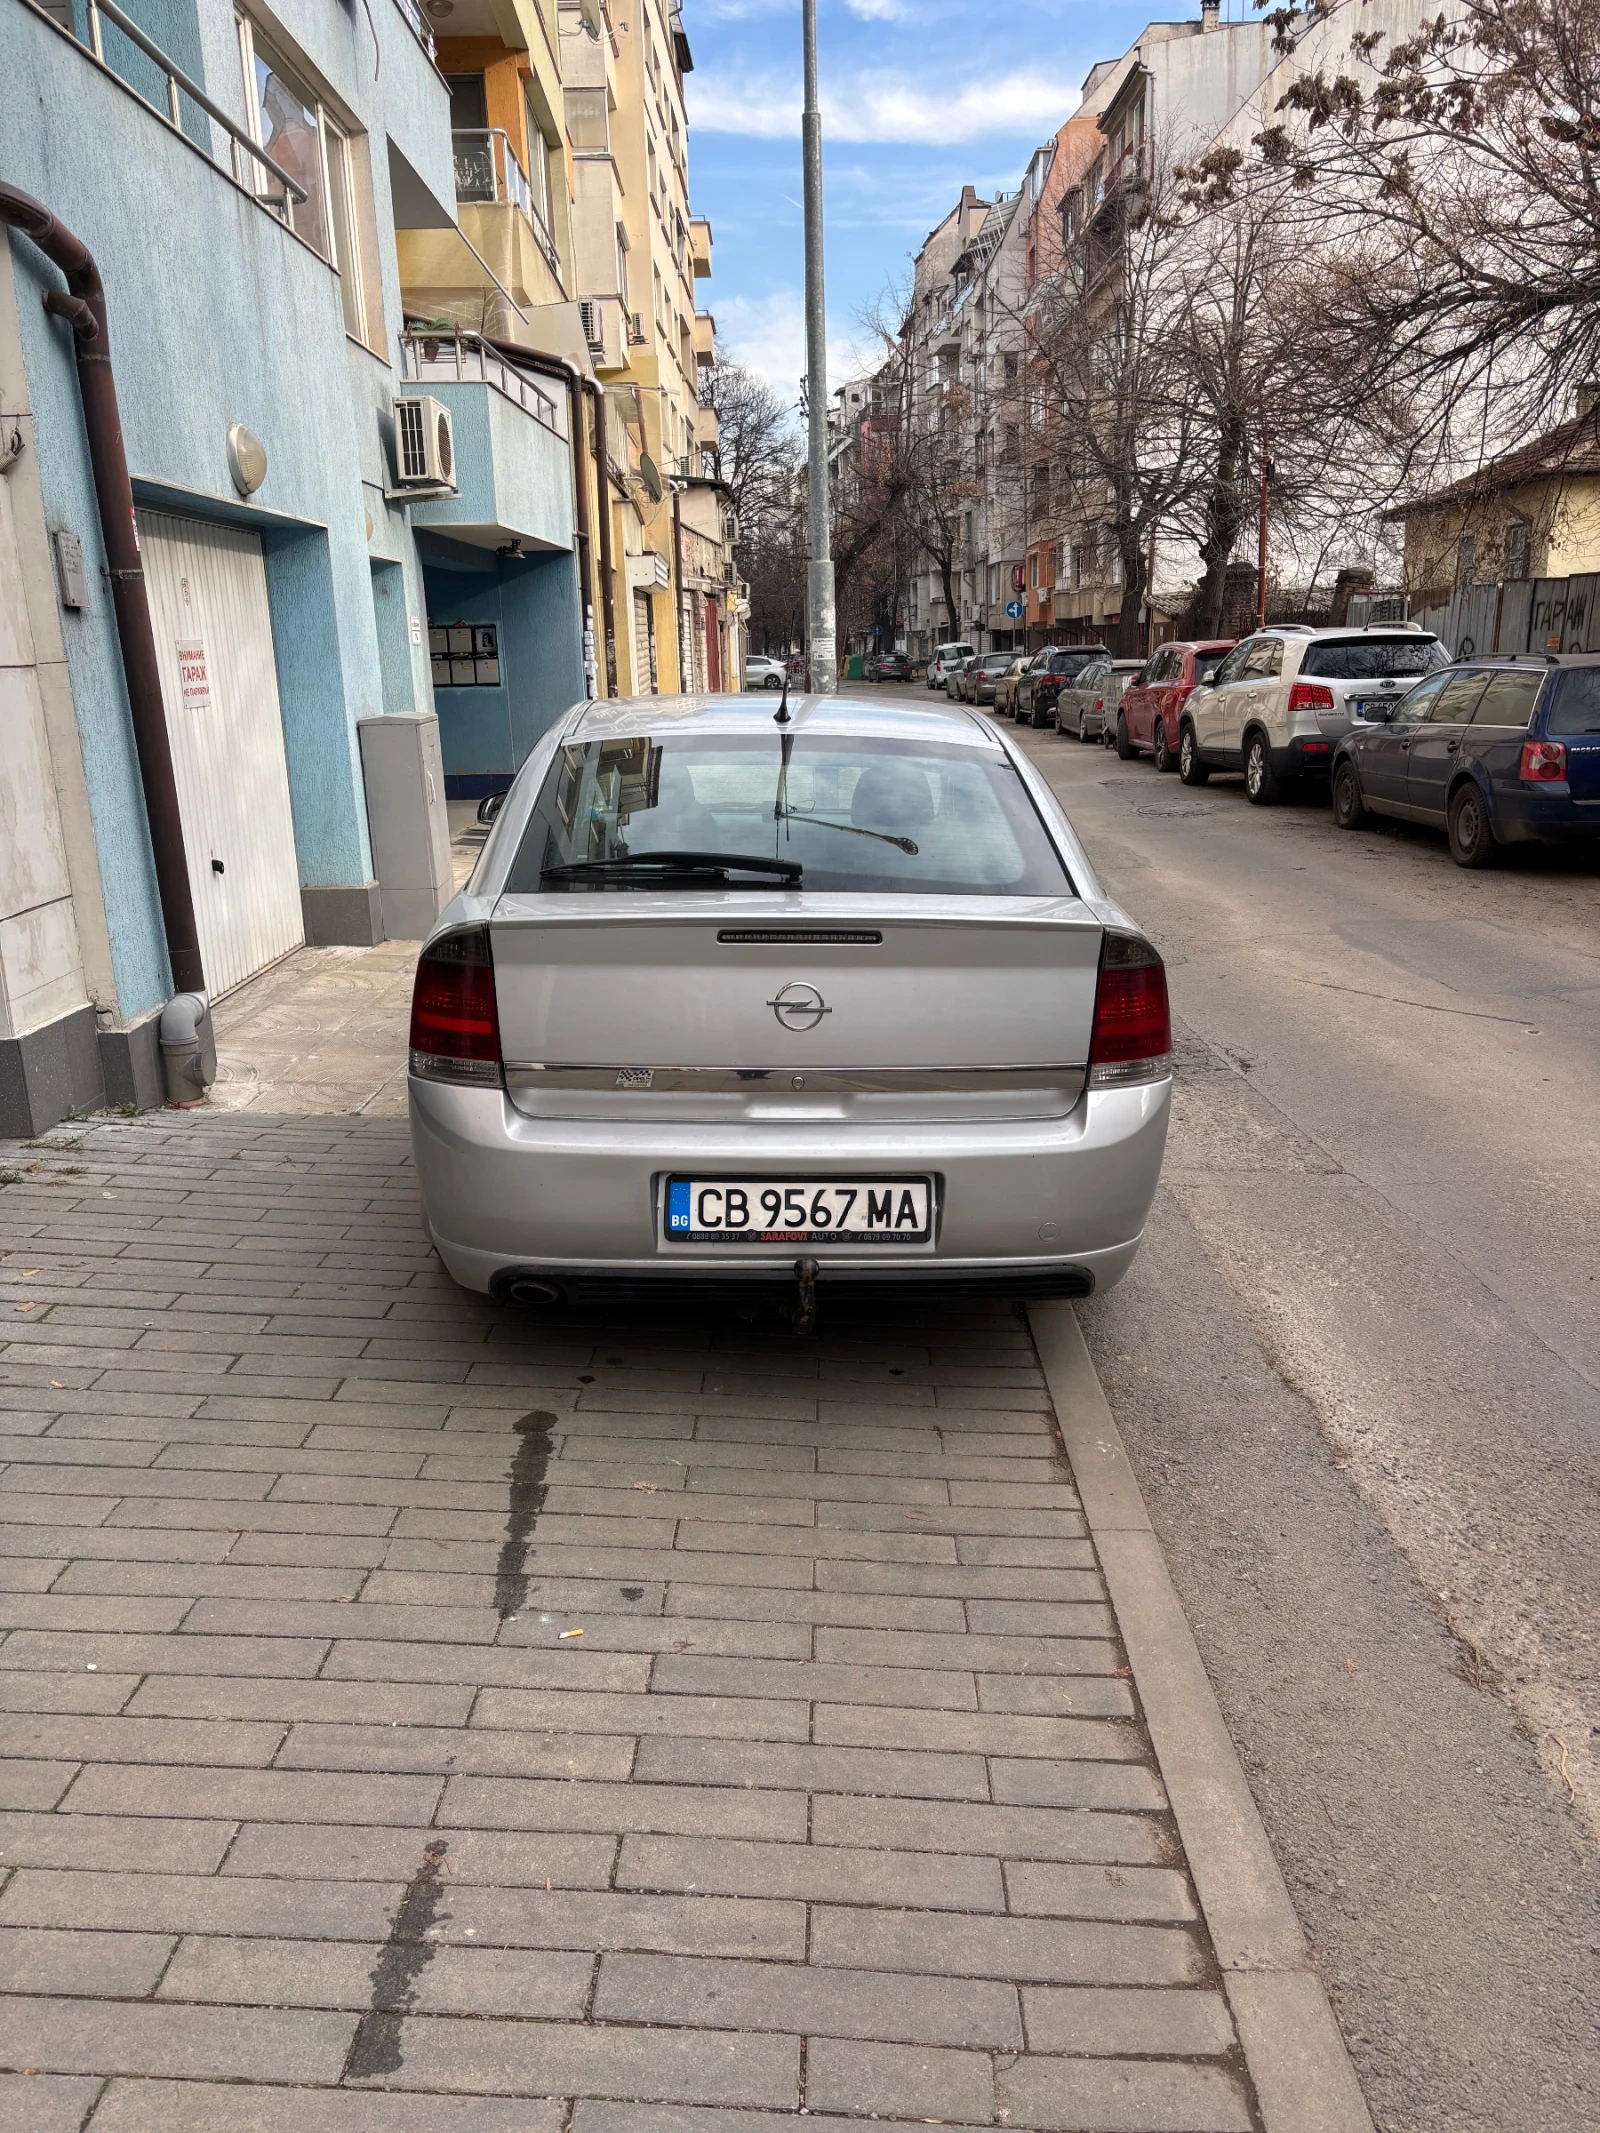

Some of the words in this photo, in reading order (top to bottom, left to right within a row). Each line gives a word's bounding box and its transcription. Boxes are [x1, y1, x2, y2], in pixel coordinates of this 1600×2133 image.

[1534, 594, 1587, 631] ГАРАЖ
[179, 650, 205, 661] ВНИМАНИЕ
[182, 666, 207, 682] ГАРАЖ
[184, 688, 190, 696] НЕ
[698, 1189, 750, 1228] CB
[761, 1189, 858, 1228] 9567
[868, 1189, 919, 1229] MA
[671, 1214, 689, 1227] BG
[692, 1232, 708, 1240] 0888
[721, 1232, 730, 1240] 35
[731, 1232, 740, 1240] 37
[760, 1231, 807, 1241] SARAFOVI
[811, 1232, 837, 1240] AUTO
[892, 1233, 901, 1241] 70
[902, 1233, 911, 1241] 70
